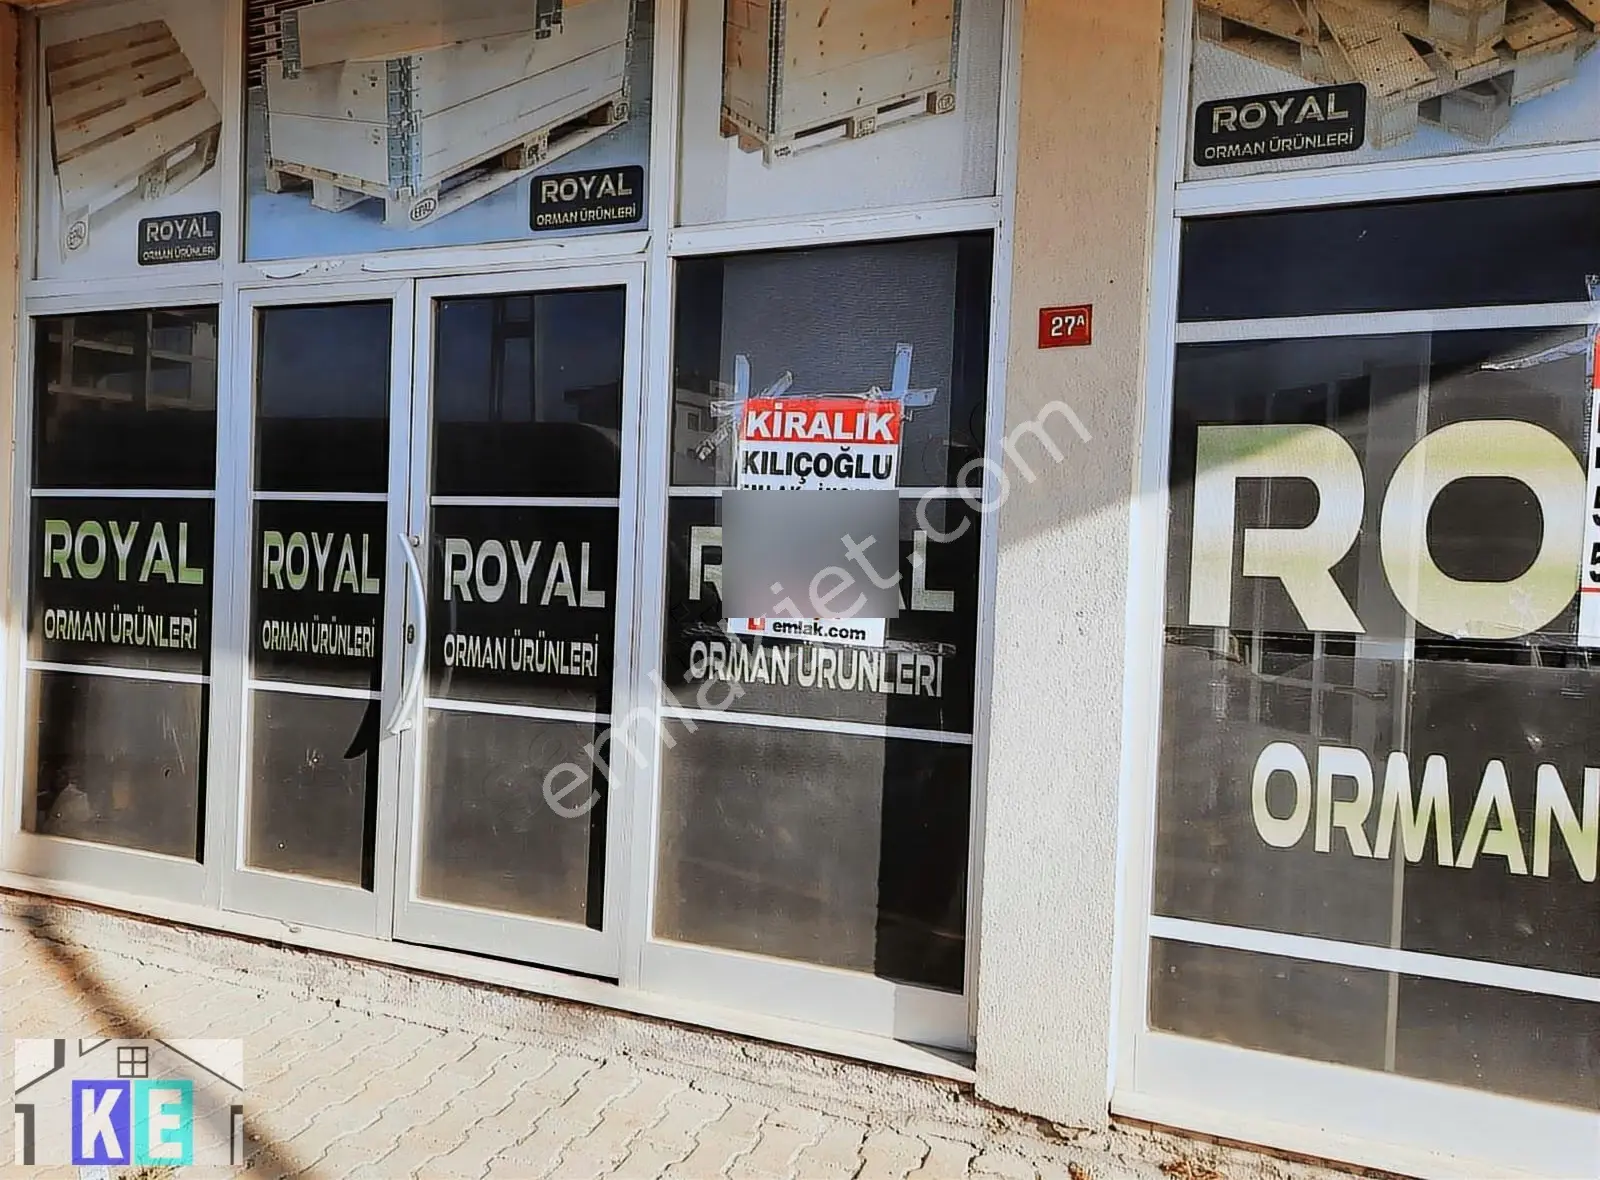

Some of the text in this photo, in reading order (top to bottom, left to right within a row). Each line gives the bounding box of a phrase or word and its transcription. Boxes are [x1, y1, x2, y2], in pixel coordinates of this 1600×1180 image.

[1212, 93, 1349, 134] ROYAL
[1204, 128, 1354, 160] ORMAN ÜRÜNLERİ
[541, 172, 632, 203] ROYAL
[146, 217, 213, 242] ROYAL
[536, 202, 636, 226] ORMAN ÜRÜNLERİ
[143, 243, 216, 261] ORMAN ÜRÜNLERİ
[1051, 315, 1085, 337] 27A
[746, 402, 895, 440] KİRALIK
[744, 446, 893, 484] KILIÇOĞLU
[44, 519, 204, 585] ROYAL
[262, 530, 380, 595] ROYAL
[443, 538, 606, 608] ROYAL
[44, 604, 198, 650] ORMAN ÜRÜNLERİ
[262, 614, 376, 658] ORMAN ÜRÜNLERİ
[772, 620, 866, 641] emlak.com
[444, 628, 599, 677] ORMAN ÜRÜNLERİ
[689, 640, 943, 698] ORMAN ÜRÜNLERİ
[1251, 741, 1600, 883] ORMAN
